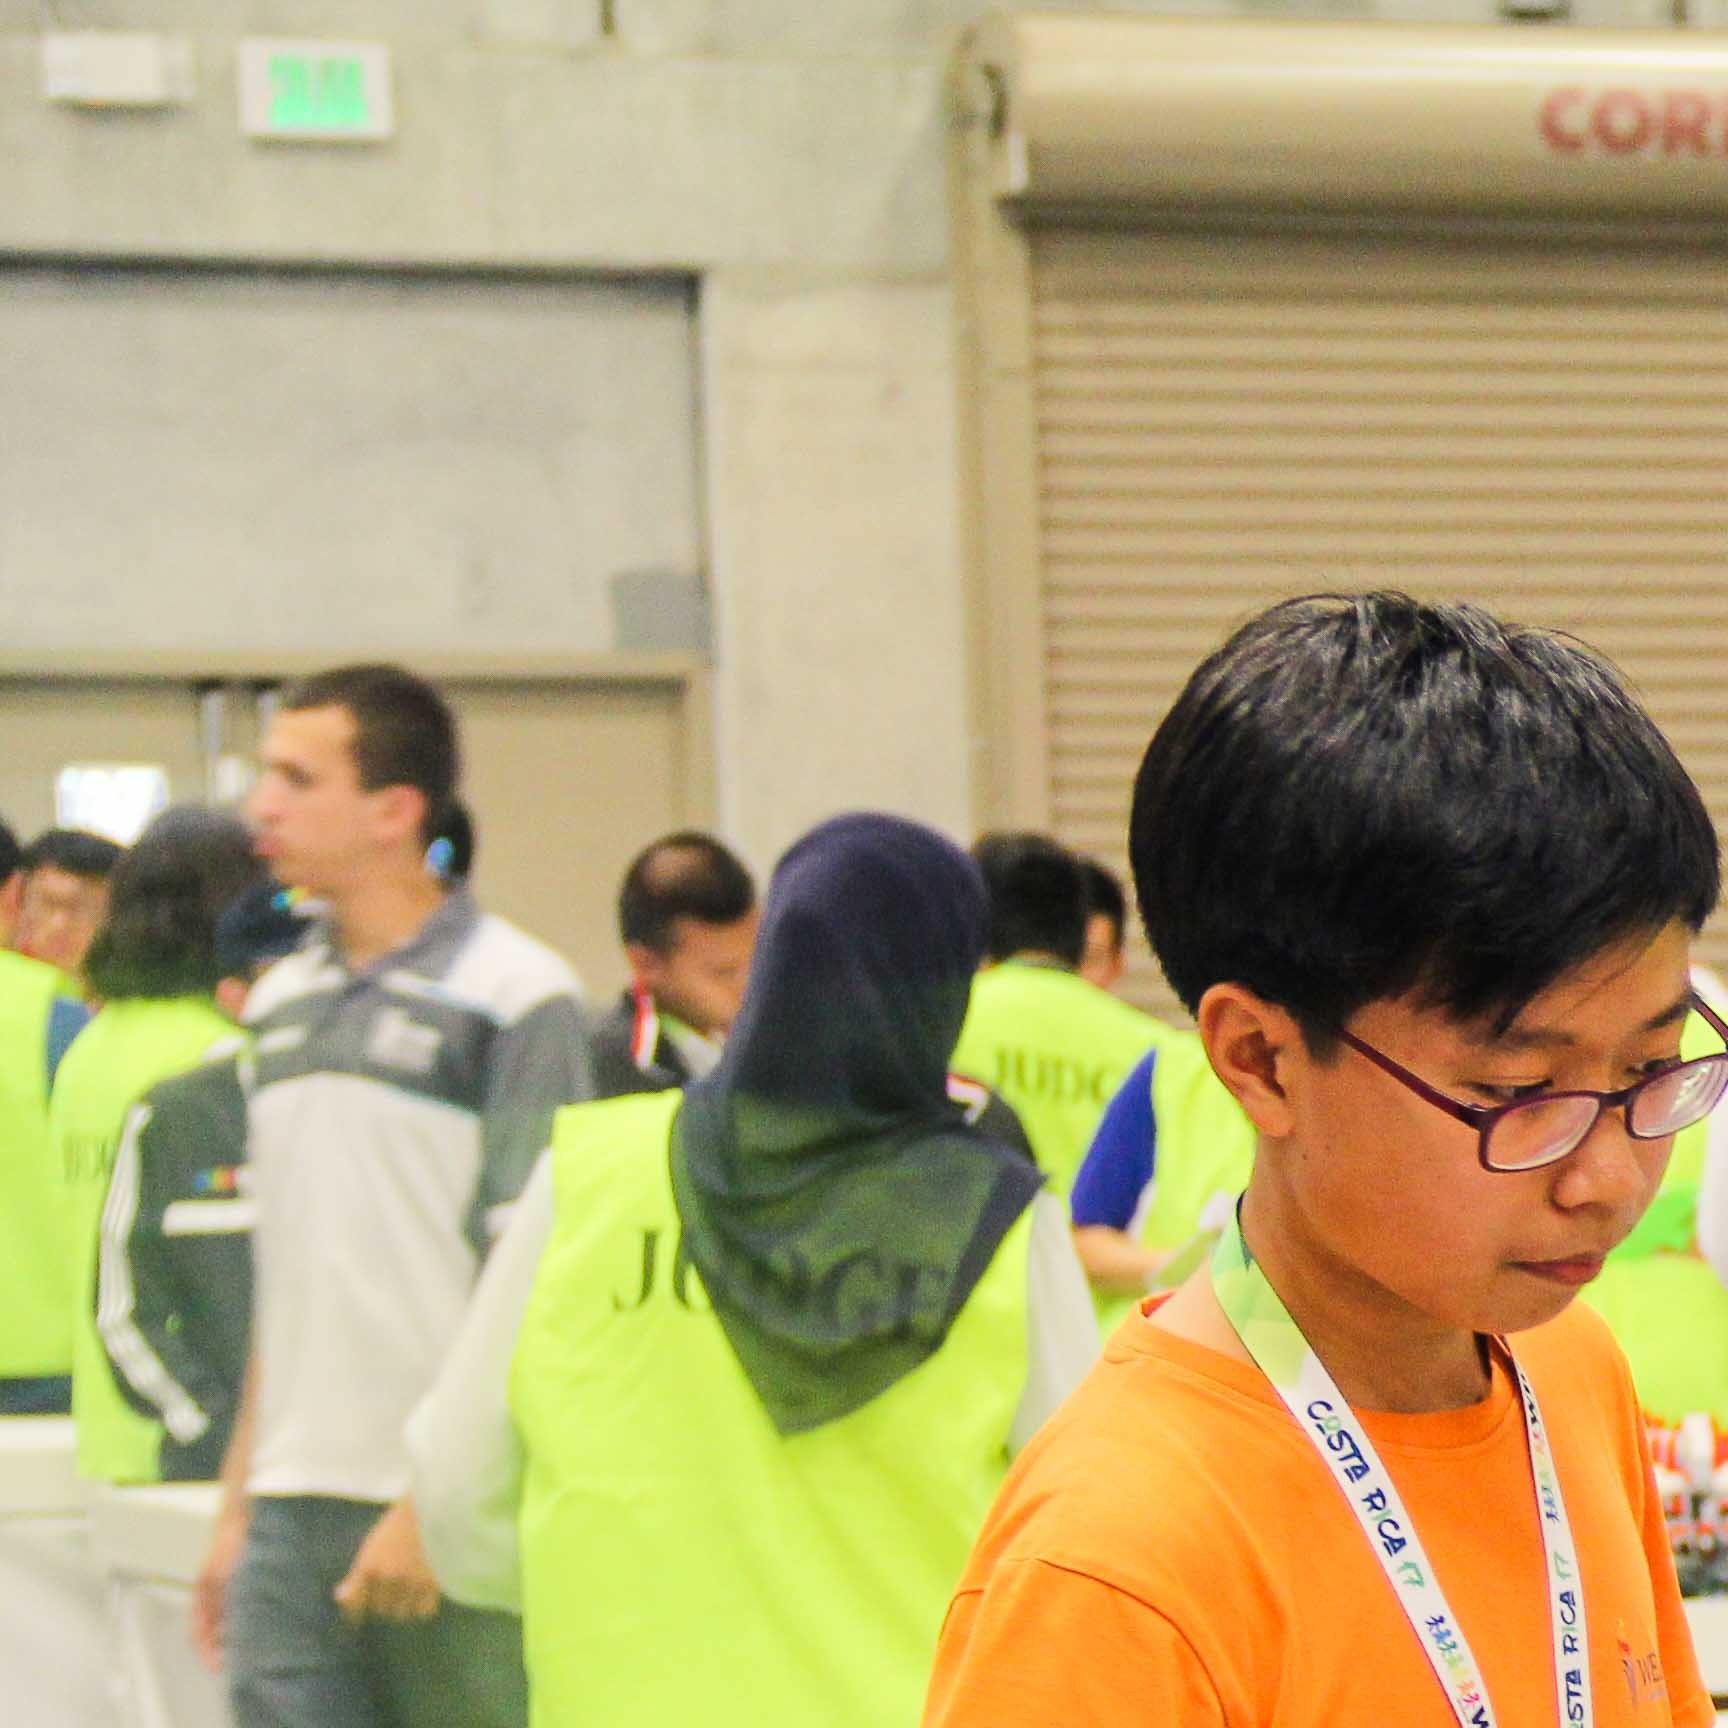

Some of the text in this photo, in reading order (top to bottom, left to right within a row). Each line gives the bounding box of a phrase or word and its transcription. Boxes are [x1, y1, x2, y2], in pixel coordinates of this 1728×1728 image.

[1307, 1400, 1370, 1484] COSTA
[1362, 1487, 1407, 1558] RICA
[1558, 1591, 1578, 1656] RICA
